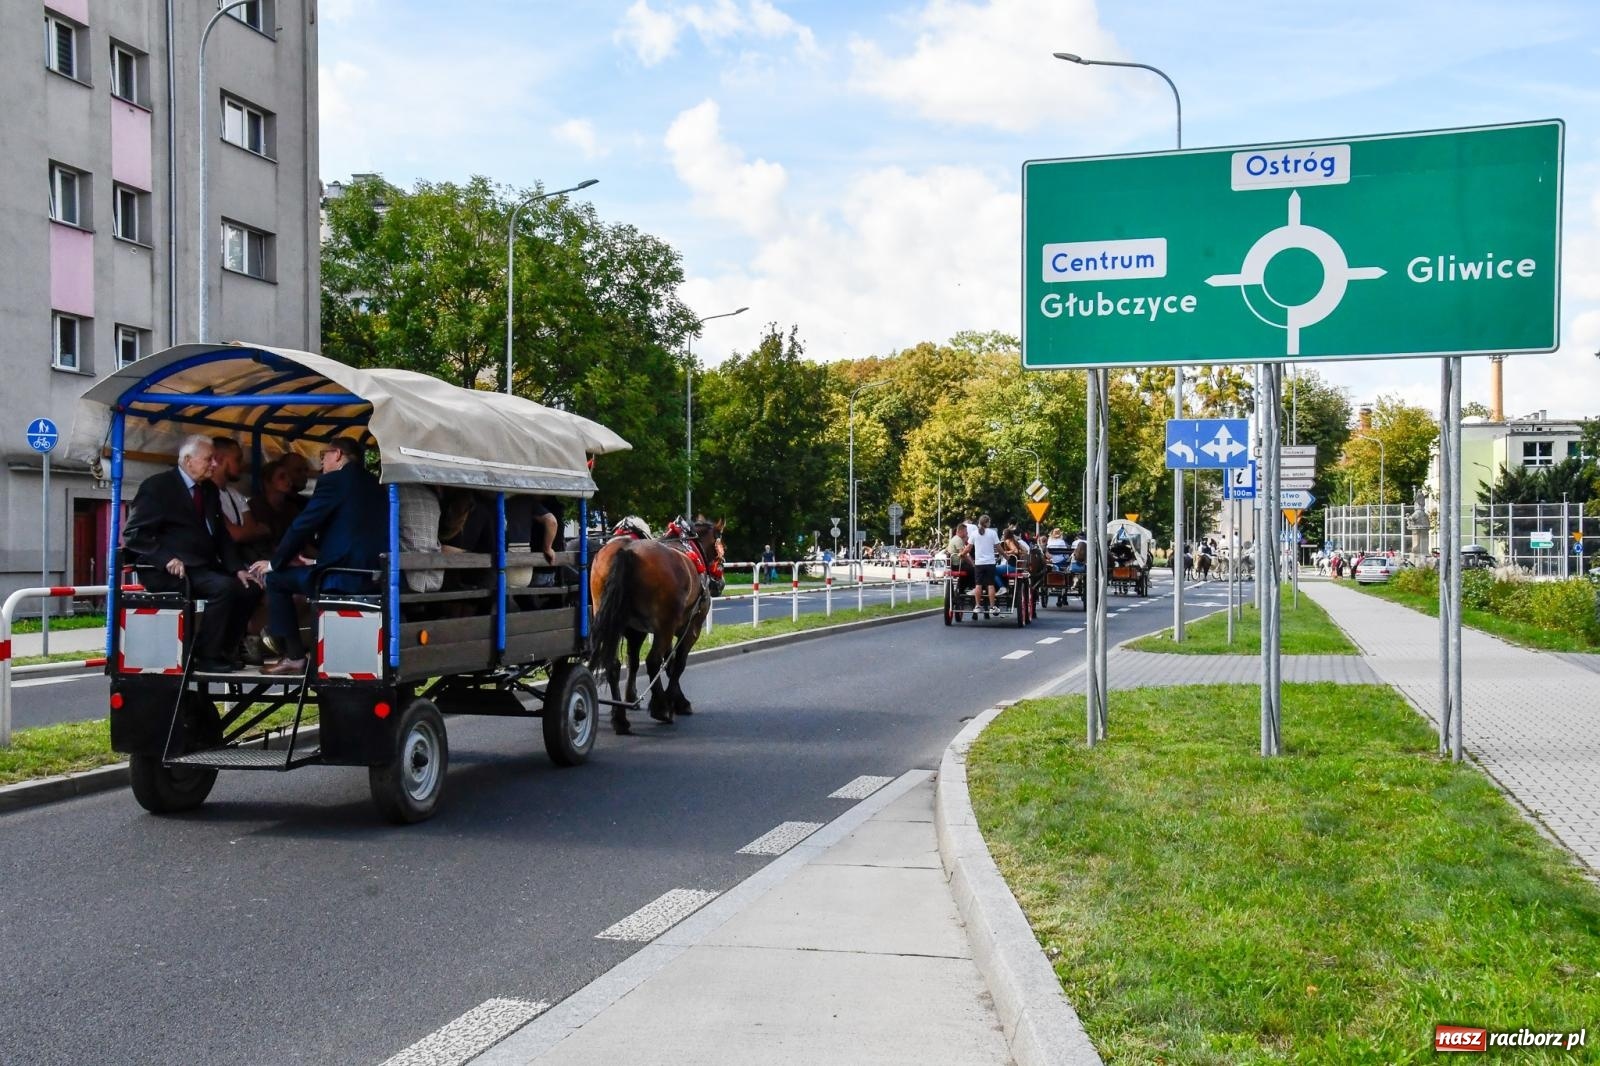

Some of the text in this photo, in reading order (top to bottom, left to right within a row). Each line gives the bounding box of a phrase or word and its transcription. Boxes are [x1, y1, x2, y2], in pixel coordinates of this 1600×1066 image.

[1245, 152, 1335, 178] Ostróg
[1052, 253, 1155, 274] Centrum
[1408, 253, 1535, 282] Gliwice
[1041, 292, 1196, 321] Głubczyce
